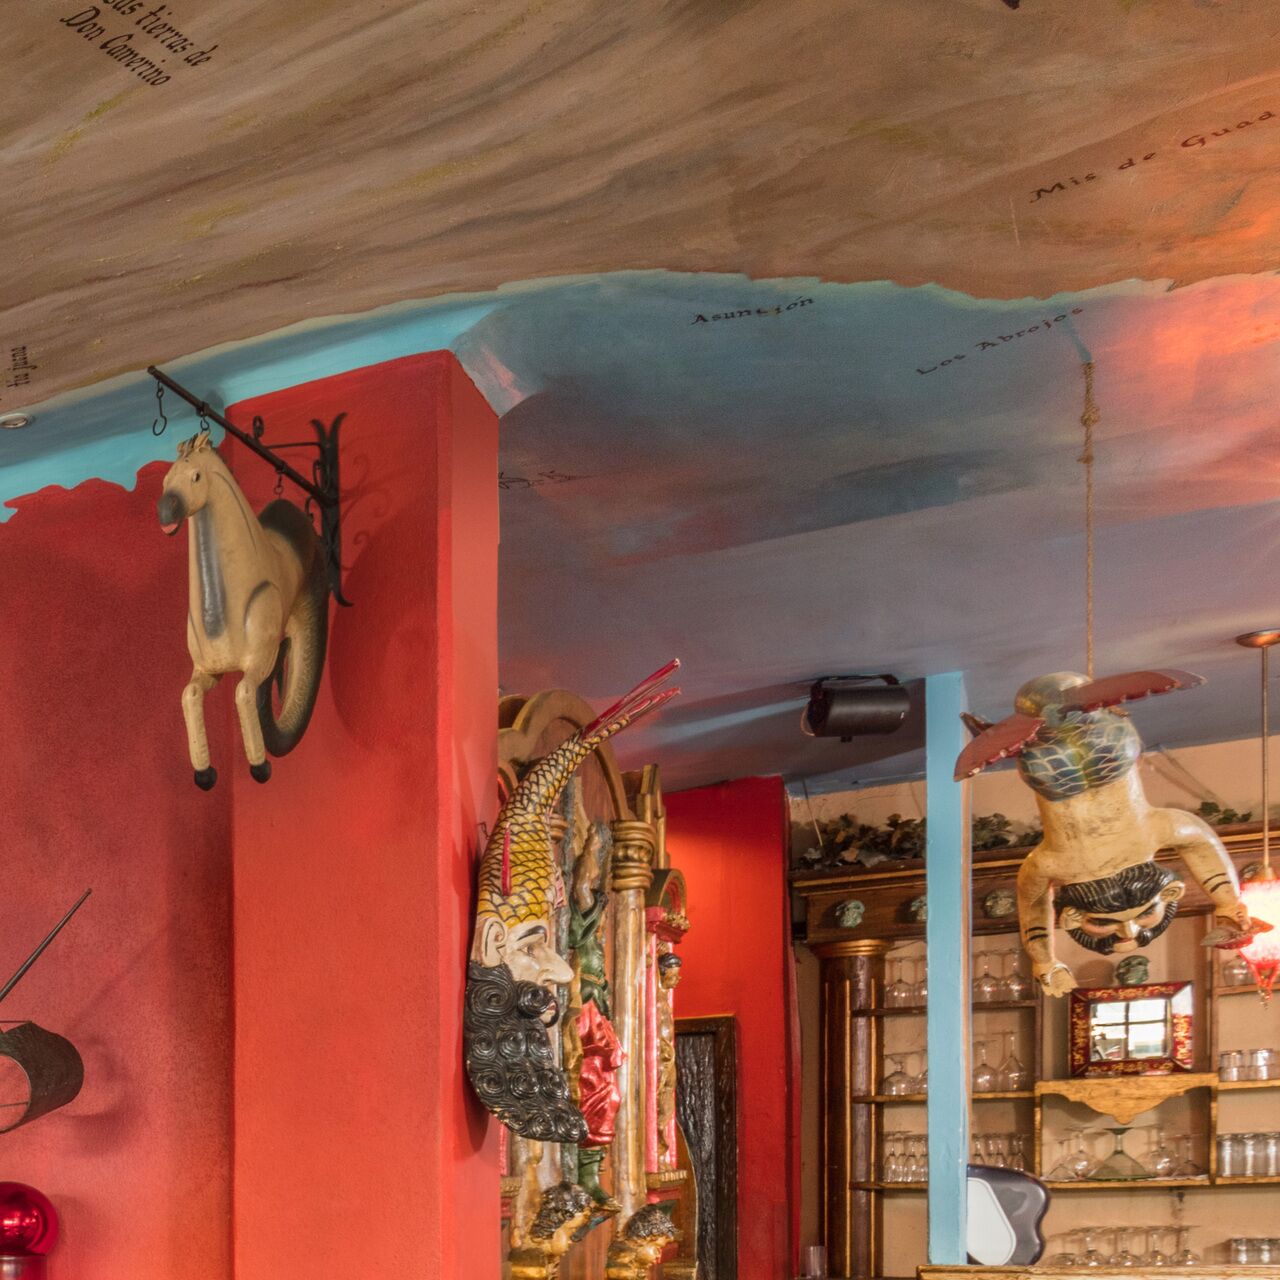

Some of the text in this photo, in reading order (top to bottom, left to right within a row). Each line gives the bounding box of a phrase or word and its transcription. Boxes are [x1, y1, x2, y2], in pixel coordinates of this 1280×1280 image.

[59, 5, 172, 86] Don Camerino
[135, 4, 194, 54] tierras
[183, 44, 219, 67] de
[1029, 172, 1097, 204] Mis
[1117, 151, 1157, 171] de
[915, 307, 1085, 376] Los Abrojos
